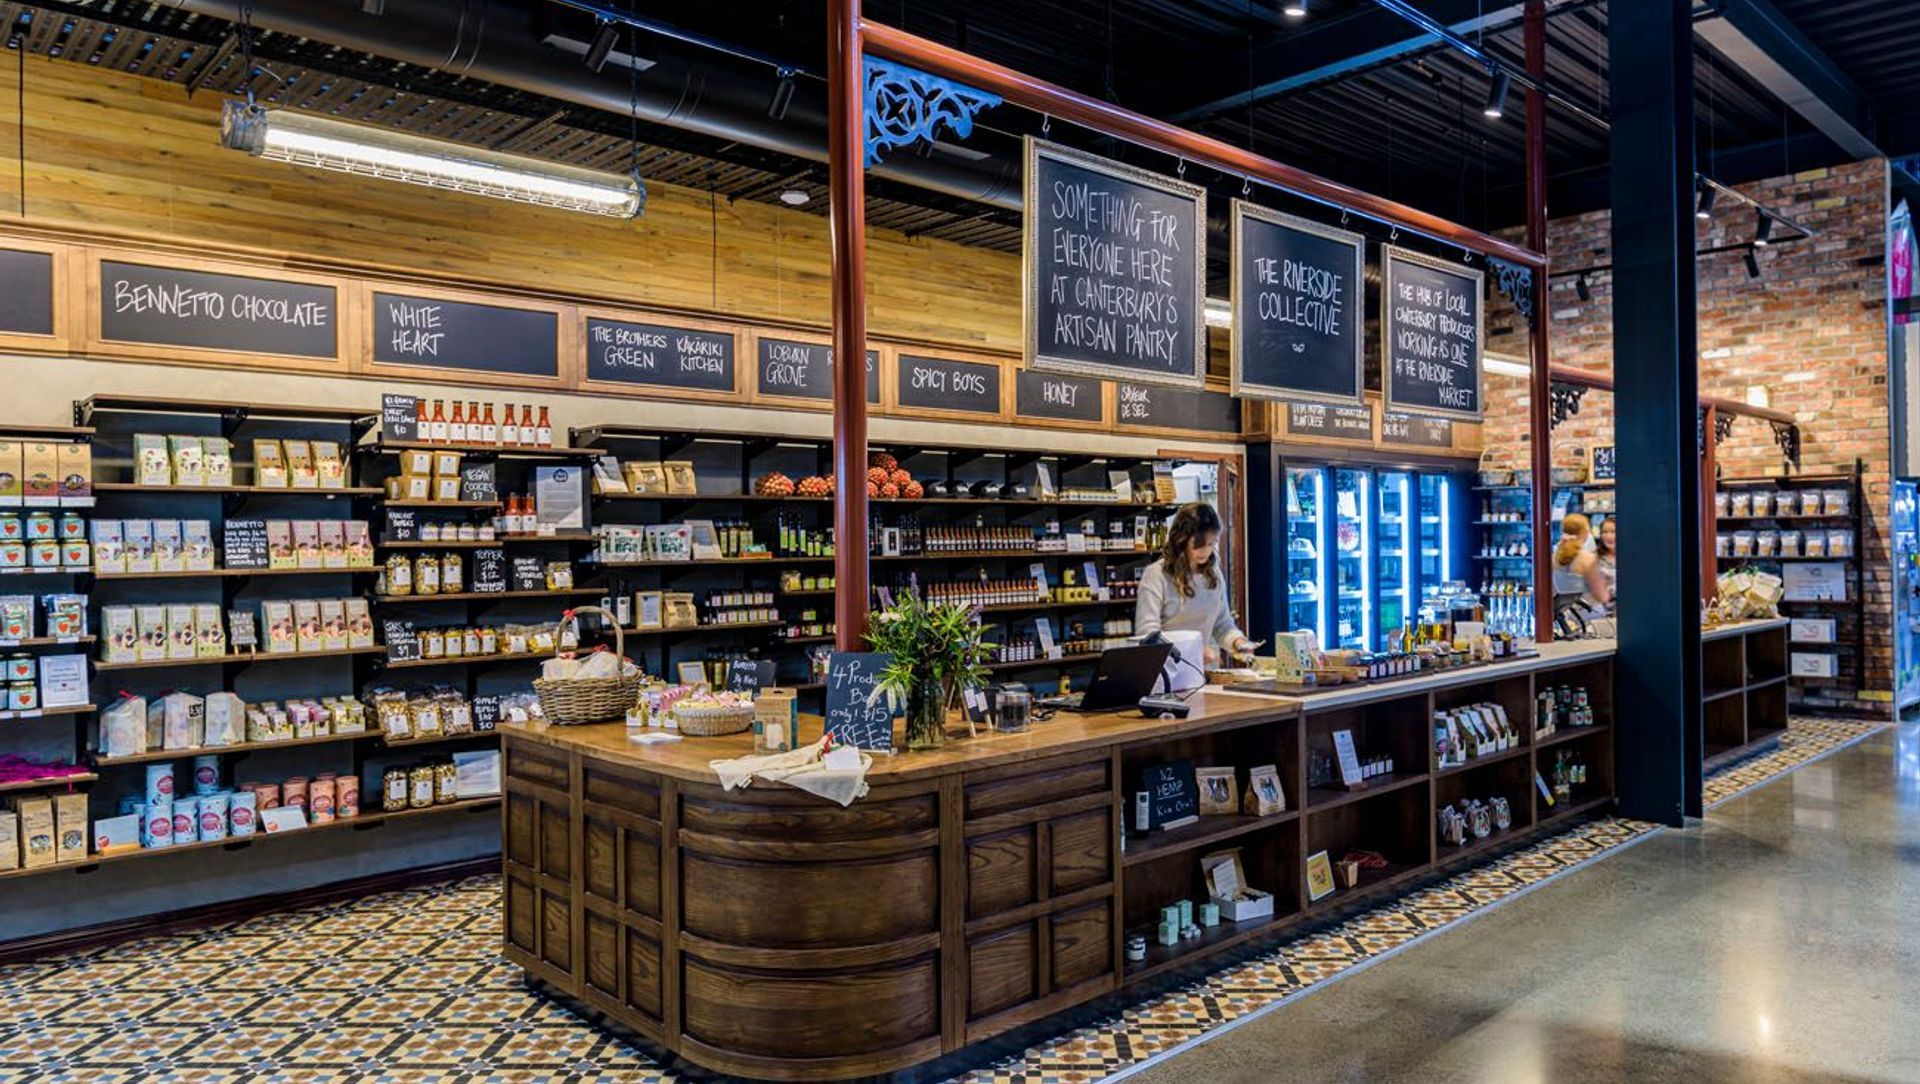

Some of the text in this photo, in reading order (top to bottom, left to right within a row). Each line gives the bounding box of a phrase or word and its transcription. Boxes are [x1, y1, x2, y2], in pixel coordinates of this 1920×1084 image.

[1052, 180, 1180, 251] SOMETHING FOR
[1053, 227, 1173, 287] EVERYONE HERE
[1254, 257, 1342, 305] THE RIVERSIDE
[114, 280, 328, 327] BENNETTO CHOCOLATE
[1051, 274, 1178, 324] AT CANTERBURY'S
[1398, 282, 1471, 317] THE HUB OF LOCAL
[389, 302, 443, 329] WHITE
[1259, 292, 1342, 336] COLLECTIVE
[1395, 306, 1475, 342] CANTERBURY PRODUCERS
[392, 329, 445, 356] HEART
[591, 326, 668, 348] THE BROTHERS
[1054, 312, 1178, 366] ARTISAN PANTRY
[1397, 327, 1470, 366] WORKING AS ONE
[604, 345, 655, 369] GREEN
[680, 355, 724, 375] KITCHEN
[766, 361, 808, 387] GROVE
[911, 366, 985, 395] SPICY BOYS
[1404, 358, 1416, 377] THE
[1418, 360, 1455, 386] RIVERSIDE
[1042, 380, 1078, 407] HONEY
[1439, 384, 1474, 408] MARKET
[1131, 402, 1150, 418] SEL
[833, 664, 847, 690] 4
[861, 706, 888, 722] $15
[1160, 767, 1175, 781] NZ
[1157, 779, 1184, 797] HEMP
